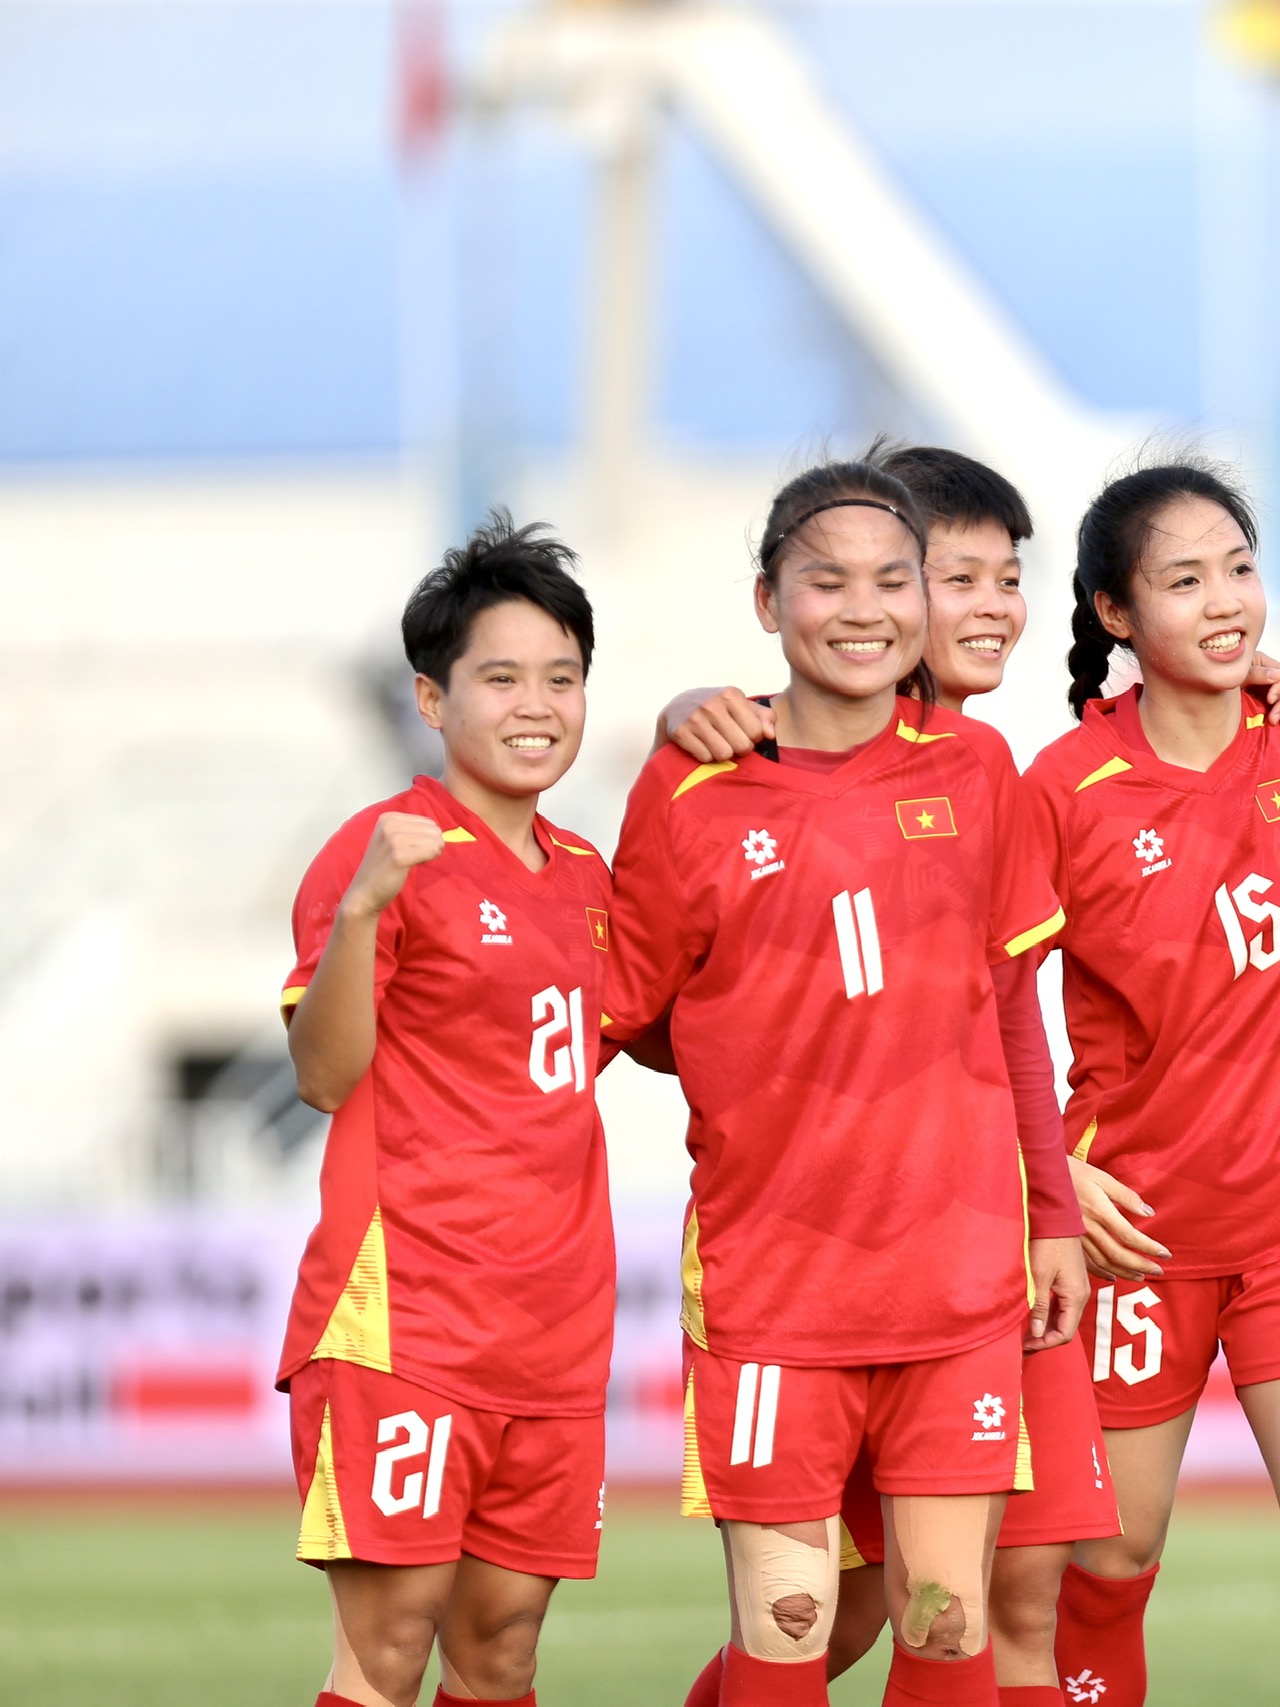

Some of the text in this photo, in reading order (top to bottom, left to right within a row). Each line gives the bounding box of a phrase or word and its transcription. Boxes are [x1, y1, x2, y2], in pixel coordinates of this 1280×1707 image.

[833, 887, 884, 999] 11
[529, 985, 587, 1094] 21
[1094, 1285, 1162, 1386] 15
[371, 1411, 452, 1519] 21
[731, 1363, 781, 1469] 11
